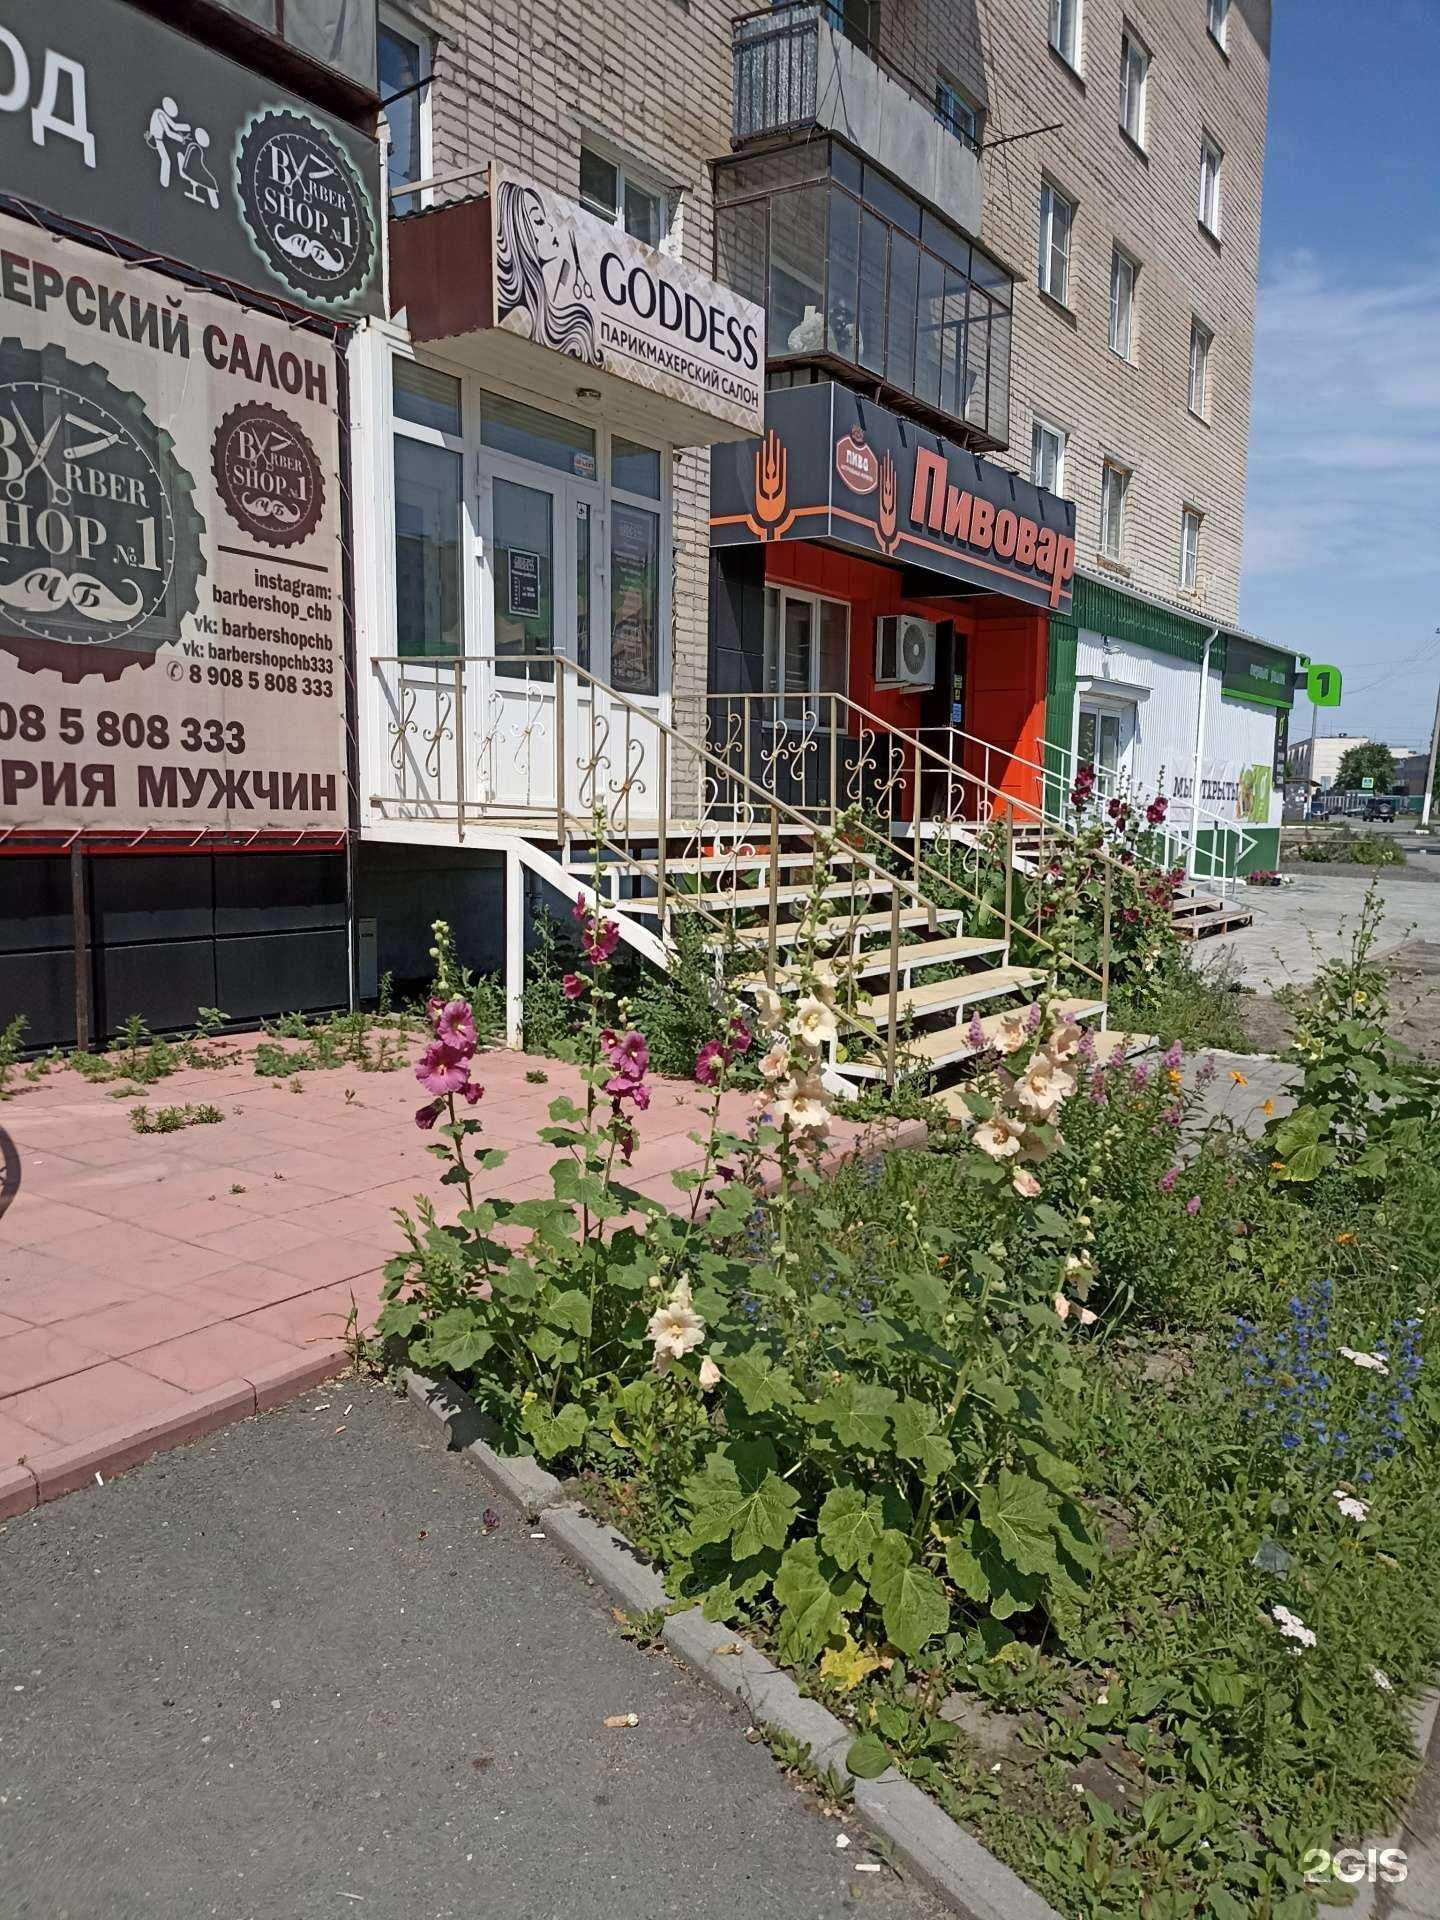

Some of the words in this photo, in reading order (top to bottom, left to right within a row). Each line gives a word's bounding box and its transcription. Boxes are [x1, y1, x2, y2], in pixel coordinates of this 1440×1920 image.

[264, 187, 328, 235] SHOP
[0, 249, 190, 358] ЕРСКИЙ
[202, 325, 328, 404] САЛОН
[600, 252, 758, 370] GODDESS
[601, 322, 720, 390] ПАРИКМАХЕРСКИЙ
[721, 380, 759, 408] САЛОН
[233, 465, 287, 495] SHOP
[911, 446, 1075, 609] Пивовар
[212, 584, 332, 622] barbershop_chb
[254, 569, 332, 600] instagram:
[194, 615, 218, 634] vk:
[222, 618, 333, 651] barbershopchb
[182, 640, 204, 658] vk:
[208, 642, 333, 674] barbershopchb333
[189, 664, 202, 684] 8
[207, 666, 243, 688] 908
[249, 671, 259, 690] 5
[264, 673, 297, 694] 808
[302, 677, 333, 698] 333
[1316, 672, 1331, 698] 1
[58, 707, 85, 745] 5
[97, 710, 170, 750] 808
[180, 717, 246, 755] 333
[2, 759, 116, 808] РИЯ
[137, 765, 337, 811] МУЖЧИН
[1173, 776, 1193, 799] МЫ
